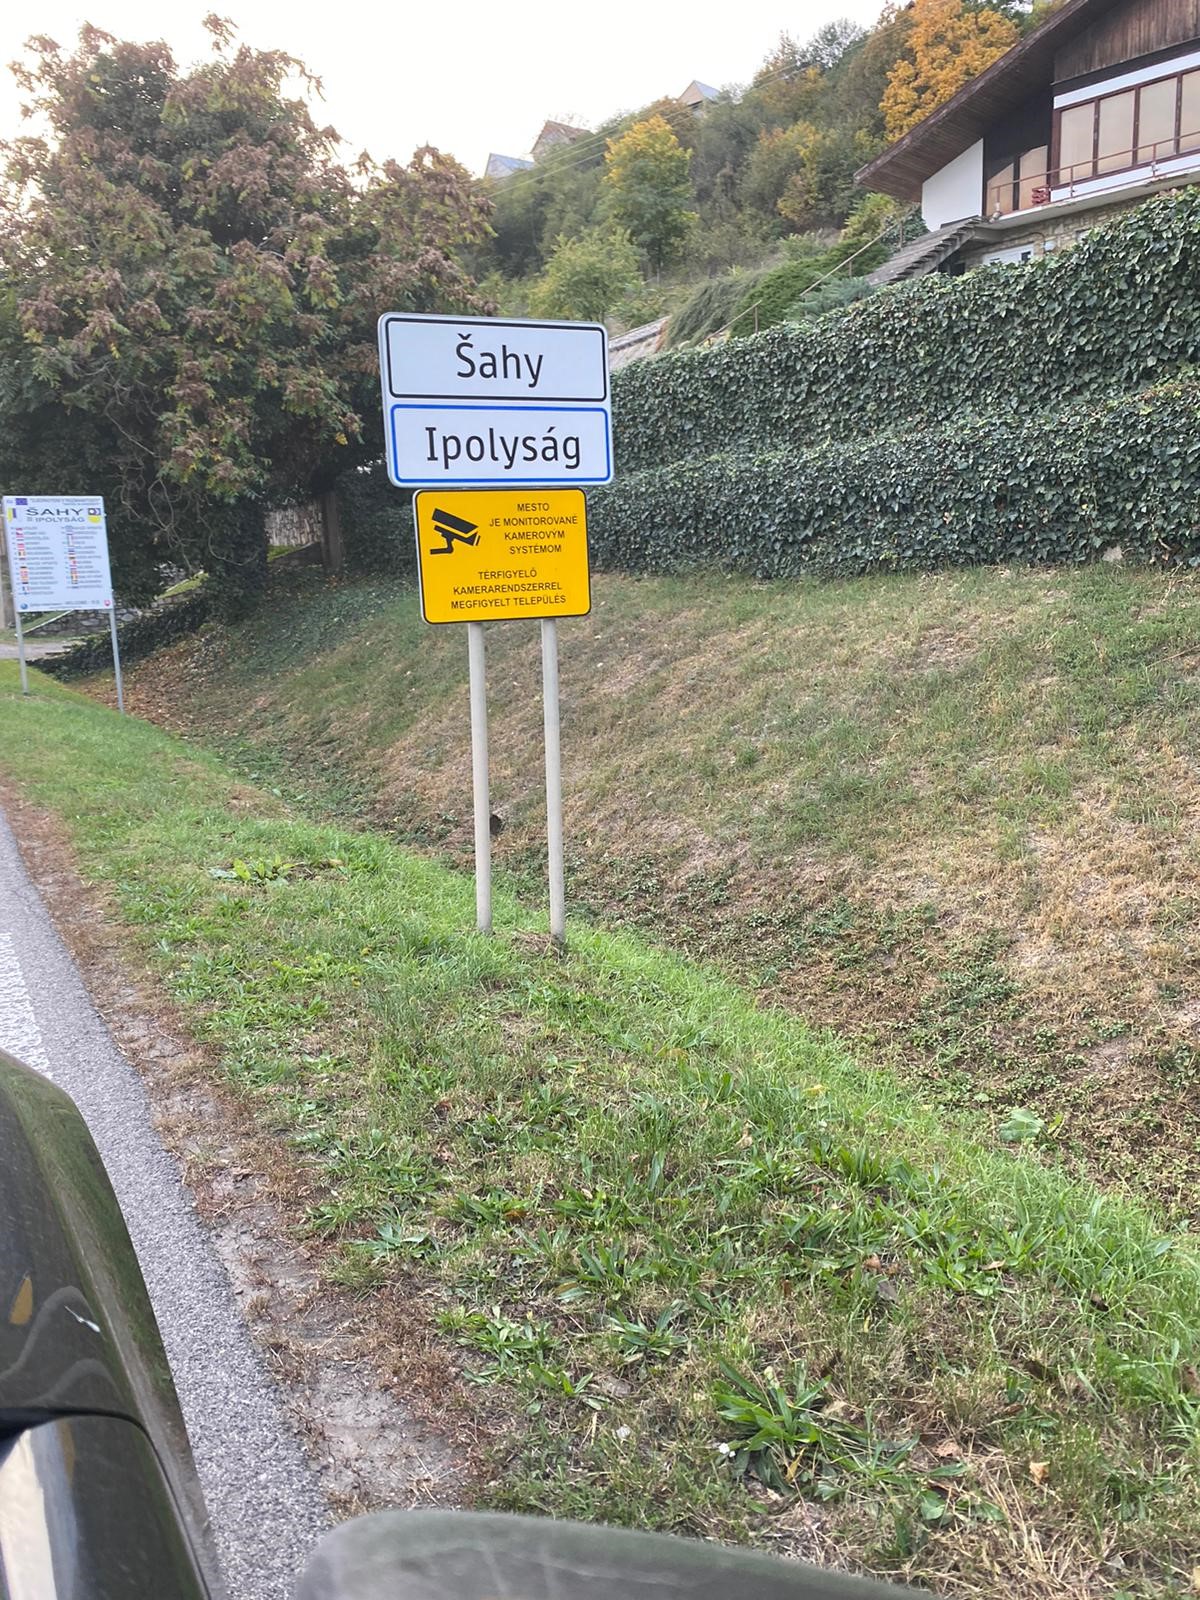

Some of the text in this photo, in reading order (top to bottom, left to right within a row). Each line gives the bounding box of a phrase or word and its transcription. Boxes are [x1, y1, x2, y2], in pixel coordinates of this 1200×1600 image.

[455, 333, 543, 388] Šahy
[425, 426, 580, 470] Ipolyság
[26, 507, 83, 516] ŠAHY
[517, 503, 550, 512] MESTO
[489, 515, 578, 527] JE MONITOROVANÉ
[504, 529, 565, 540] KAMEROVÝM
[509, 544, 561, 555] SYSTÉMOM
[478, 568, 537, 580] TÉRFIGYELŐ
[453, 582, 562, 595] KAMERARENDSZERREL
[451, 595, 566, 609] MEGFIGYELT TELEPÜLÉS
